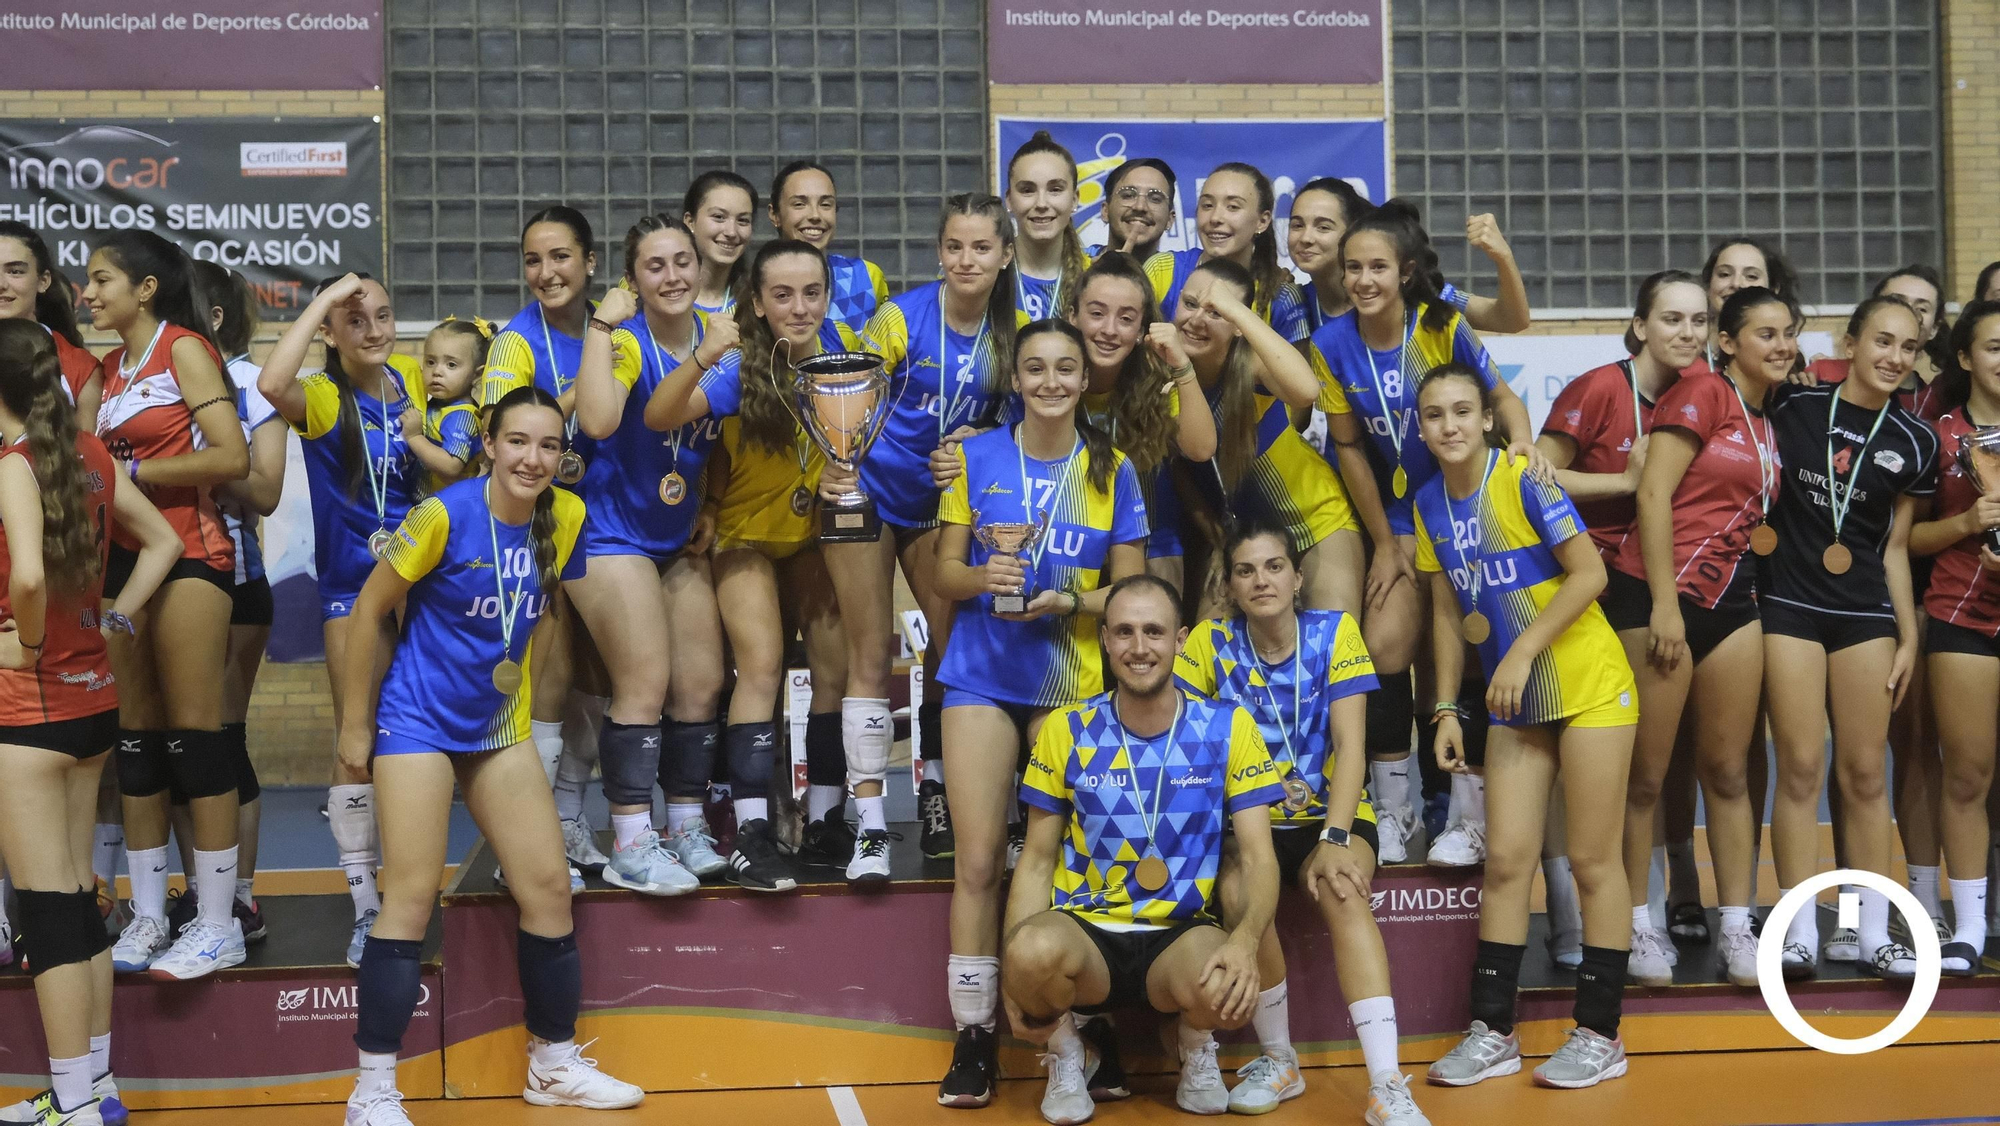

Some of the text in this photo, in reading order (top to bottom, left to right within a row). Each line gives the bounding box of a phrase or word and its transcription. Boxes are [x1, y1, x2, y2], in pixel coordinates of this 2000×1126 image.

[60, 12, 157, 34] Municipal
[161, 13, 187, 30] de
[192, 12, 282, 34] Deportes
[286, 12, 370, 31] Córdoba
[1005, 9, 1370, 30] Instituto Municipal de Deportes Córdoba
[165, 202, 371, 230] SEMINUEVOS
[193, 233, 341, 267] OCASIÓN
[248, 281, 302, 309] NET
[1025, 293, 1043, 322] 9
[955, 354, 976, 384] 2
[1383, 369, 1401, 398] 8
[1832, 445, 1853, 475] 4
[1021, 477, 1057, 508] 17
[1453, 516, 1482, 550] 20
[502, 547, 532, 579] 10
[1178, 650, 1200, 669] decor
[1232, 760, 1274, 783] VOLE
[1390, 886, 1483, 911] IMDEC
[1388, 914, 1424, 923] Municipal
[1425, 913, 1435, 921] de
[1435, 912, 1468, 921] Deportes
[278, 1013, 310, 1022] Instituto
[310, 1011, 348, 1021] Municipal
